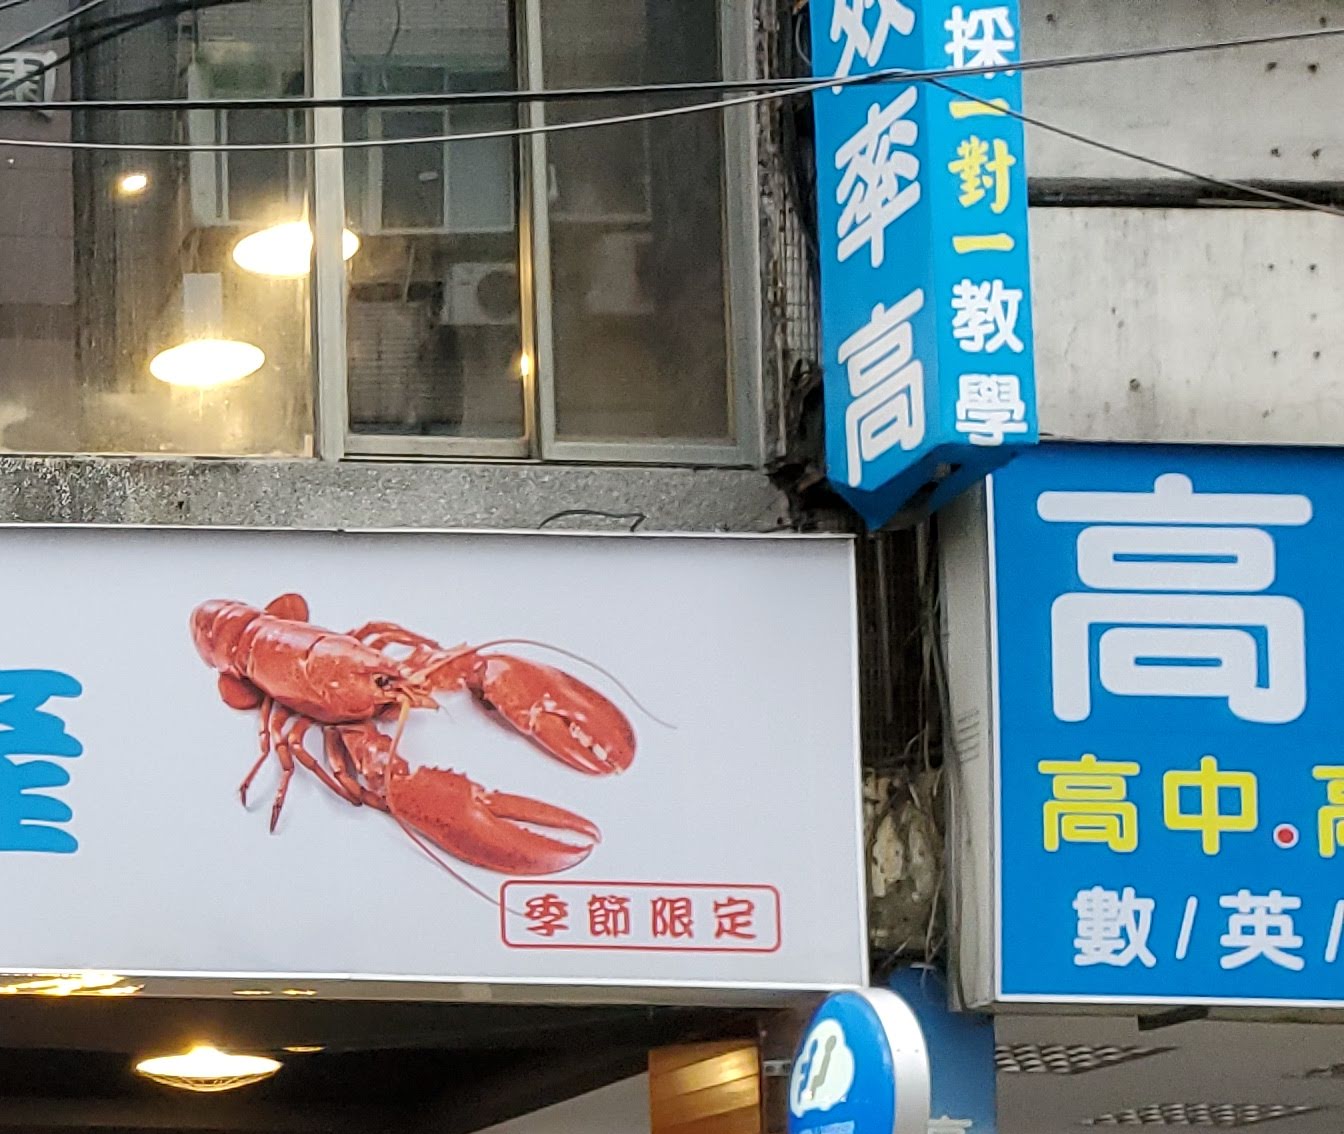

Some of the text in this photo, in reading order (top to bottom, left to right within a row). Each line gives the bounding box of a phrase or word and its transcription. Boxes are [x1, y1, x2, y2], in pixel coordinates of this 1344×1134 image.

[944, 4, 1028, 446] 採一對一教學
[1036, 473, 1313, 724] 高
[523, 892, 757, 940] 季節限定
